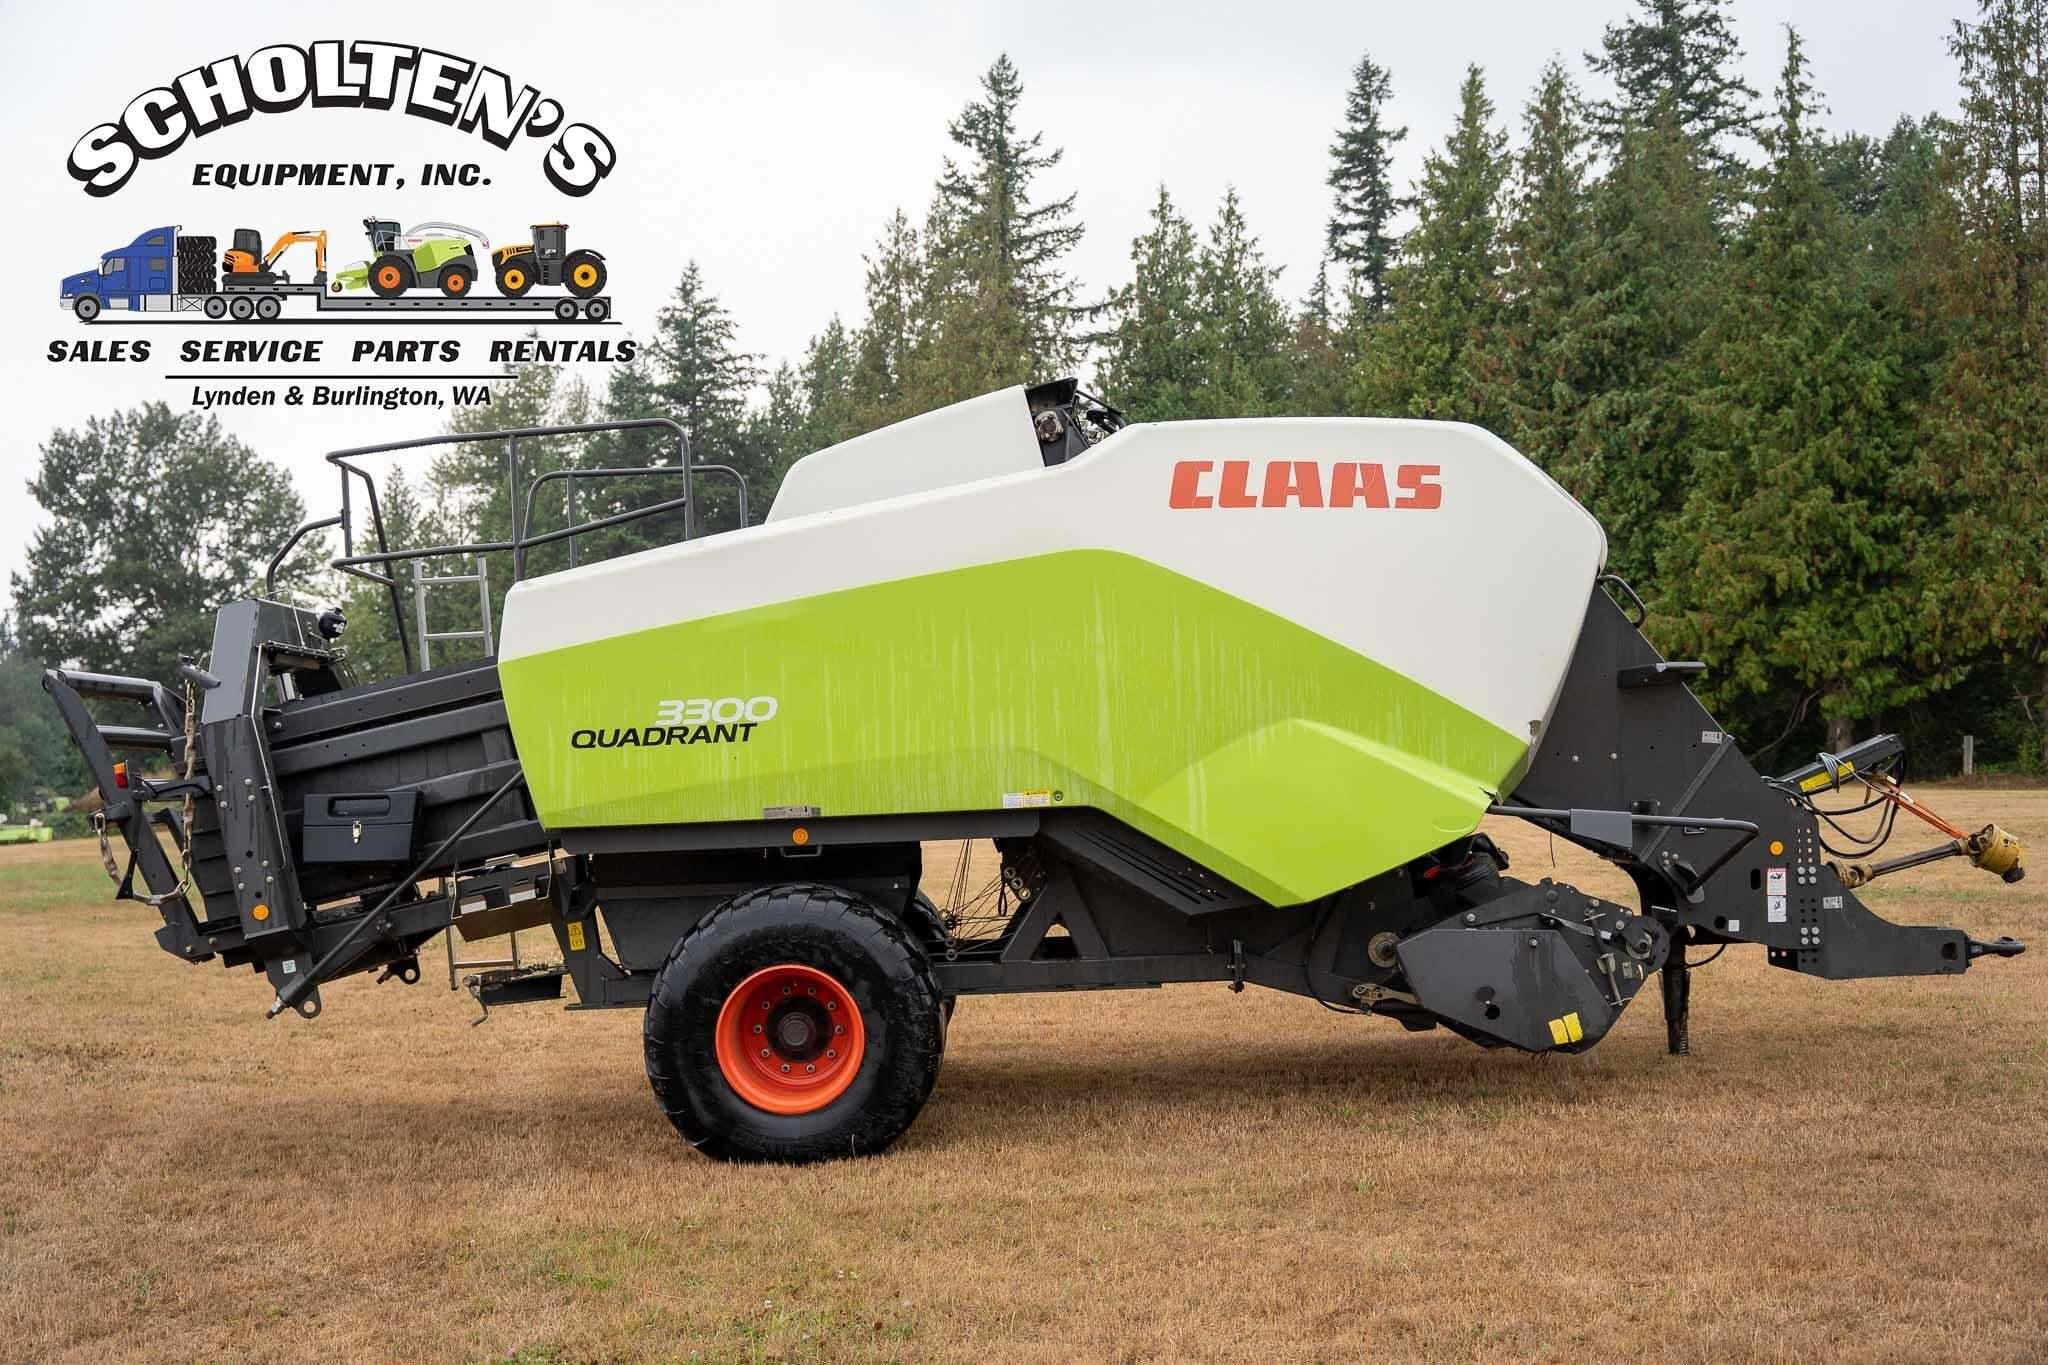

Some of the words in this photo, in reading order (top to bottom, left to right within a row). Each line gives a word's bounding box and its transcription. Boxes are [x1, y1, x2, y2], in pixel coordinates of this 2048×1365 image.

[1169, 460, 1442, 510] CLAAS
[655, 696, 778, 727] 3300
[571, 722, 758, 749] QUADRANT
